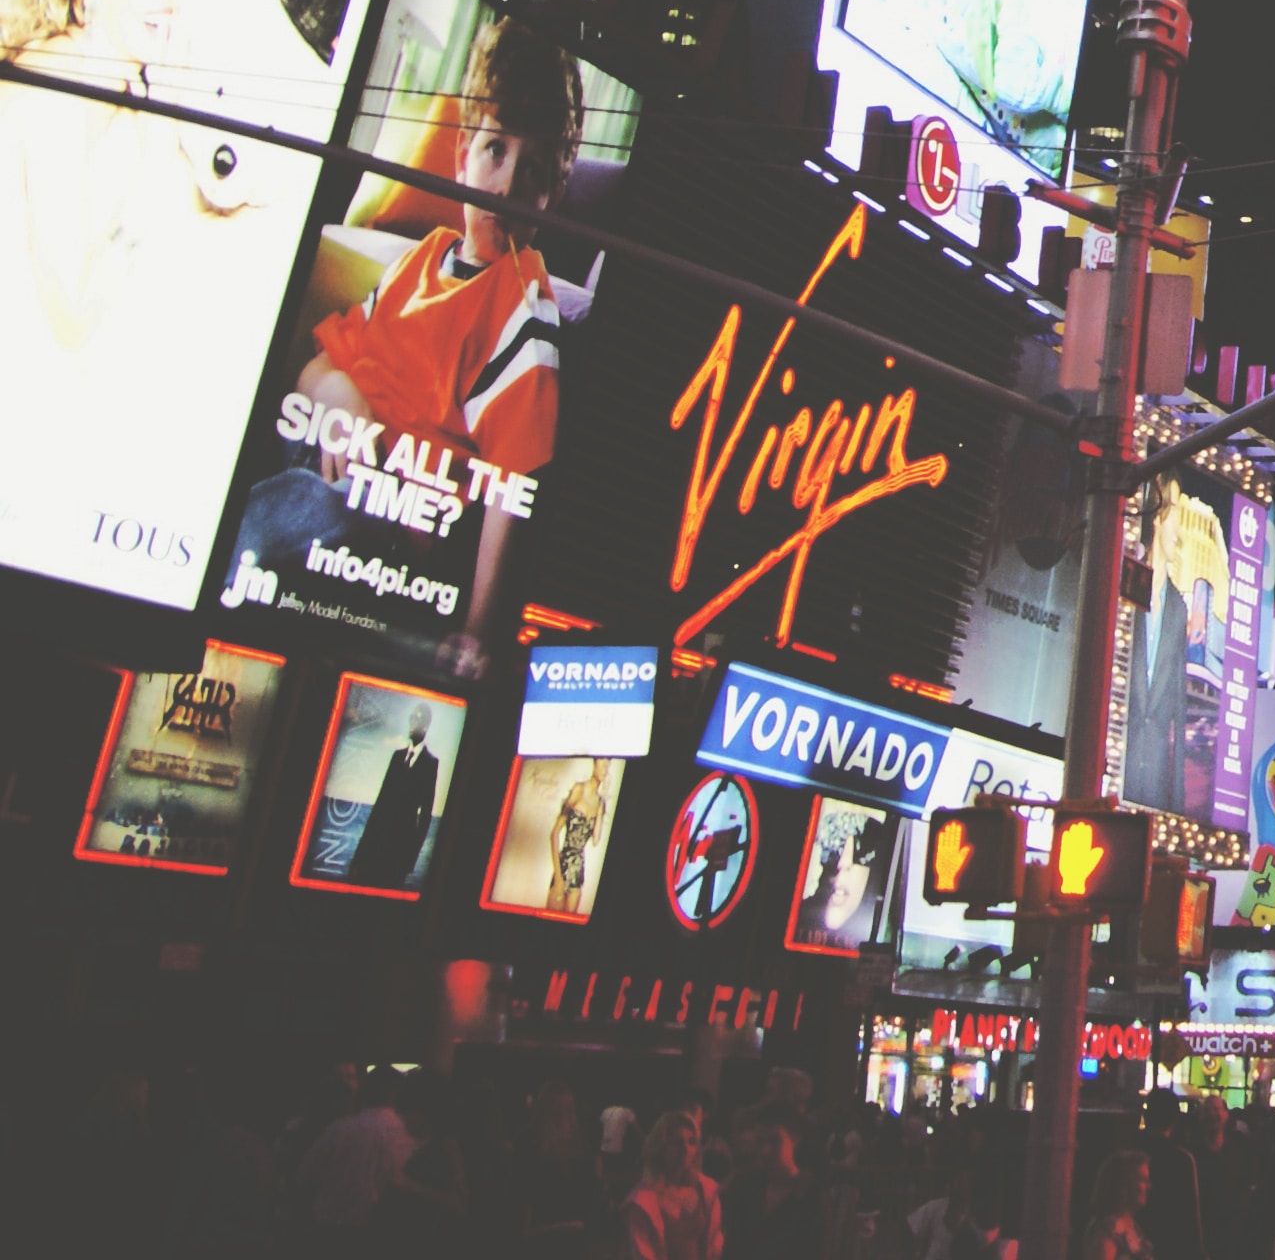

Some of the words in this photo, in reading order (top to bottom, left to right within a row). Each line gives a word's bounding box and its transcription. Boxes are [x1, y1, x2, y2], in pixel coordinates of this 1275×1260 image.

[671, 201, 948, 649] Virgin
[276, 393, 386, 466] SICK
[384, 433, 459, 494] ALL
[466, 458, 539, 519] THE
[345, 463, 463, 538] TIME?
[91, 509, 195, 568] TOUS
[219, 549, 279, 609] jm
[276, 591, 306, 613] Jeffrey
[308, 599, 341, 620] Modell
[306, 538, 460, 616] info4pi.org
[984, 587, 1020, 617] TIMES
[529, 662, 657, 683] VORNADO
[548, 681, 592, 691] REALTY
[596, 681, 635, 691] TRUST
[722, 684, 936, 791] VORNADO
